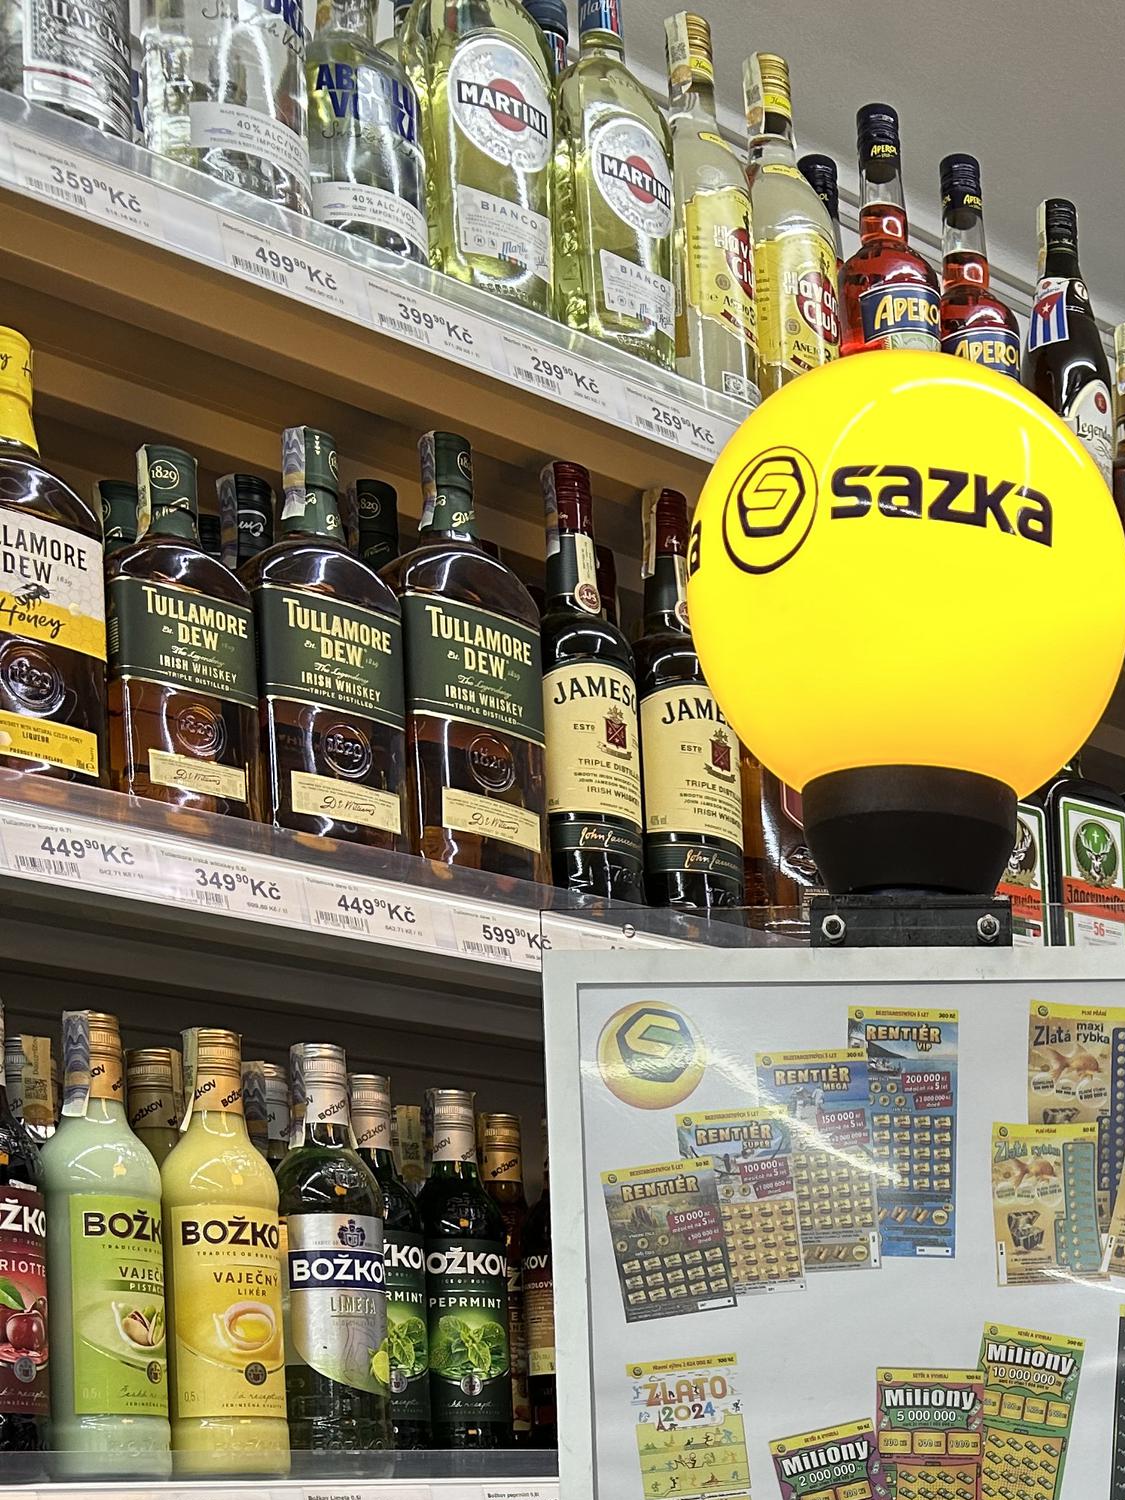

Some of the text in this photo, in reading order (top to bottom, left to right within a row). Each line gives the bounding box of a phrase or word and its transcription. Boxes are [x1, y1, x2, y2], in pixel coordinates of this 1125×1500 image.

[460, 84, 548, 136] MARTINI
[603, 154, 671, 208] MARTINI
[480, 201, 538, 230] BIANCO
[784, 271, 839, 314] Havan
[142, 586, 248, 639] TULLAMORE
[283, 597, 392, 655] TULLAMORE
[425, 605, 532, 666] TULLAMORE
[160, 654, 237, 683] IRISH WHISKEY
[167, 671, 192, 682] TRIPLE
[301, 672, 381, 702] IRISH WHISKEY
[554, 676, 636, 715] JAMES
[865, 1024, 942, 1044] RENTIÉR
[1076, 1021, 1104, 1032] maxi
[1076, 1031, 1110, 1045] rybka
[916, 1042, 933, 1052] VIP
[774, 1065, 851, 1085] RENTIÉR
[822, 1082, 848, 1091] MEGA
[695, 1124, 773, 1145] RENTIÉR
[742, 1140, 772, 1150] SUPER
[621, 1176, 698, 1202] RENTIÉR
[181, 1216, 279, 1248] BOŽKO
[292, 1253, 385, 1284] BOŽKO
[428, 1296, 502, 1309] PEPRMINT
[987, 1343, 1076, 1375] Miliony
[642, 1376, 728, 1406] ZLATO
[884, 1388, 976, 1410] Miliony
[661, 1402, 716, 1422] 2024
[781, 1439, 870, 1476] Miliony
